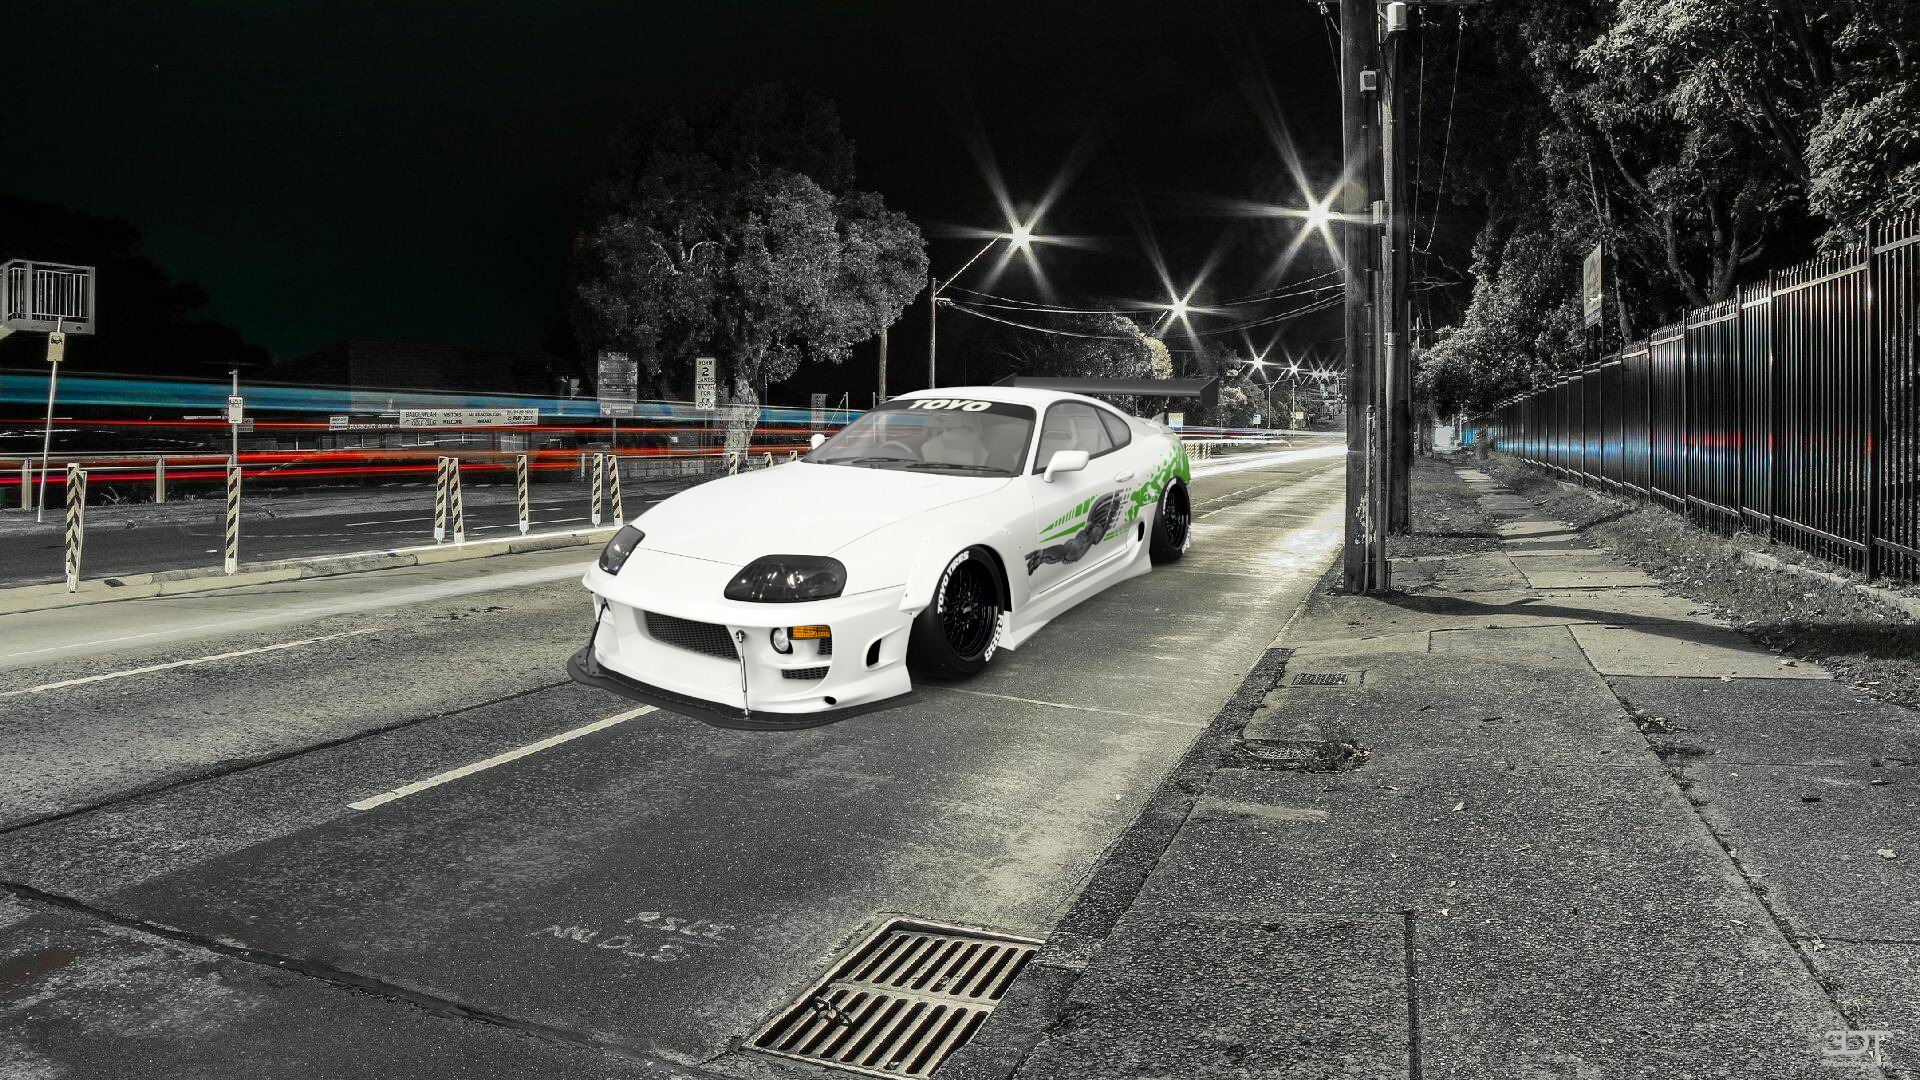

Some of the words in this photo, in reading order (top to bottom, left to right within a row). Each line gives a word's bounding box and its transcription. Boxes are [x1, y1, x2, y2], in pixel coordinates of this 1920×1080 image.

[702, 367, 710, 377] 2
[908, 399, 992, 411] TOYO
[937, 574, 949, 614] TOYO
[946, 550, 970, 577] TIRES
